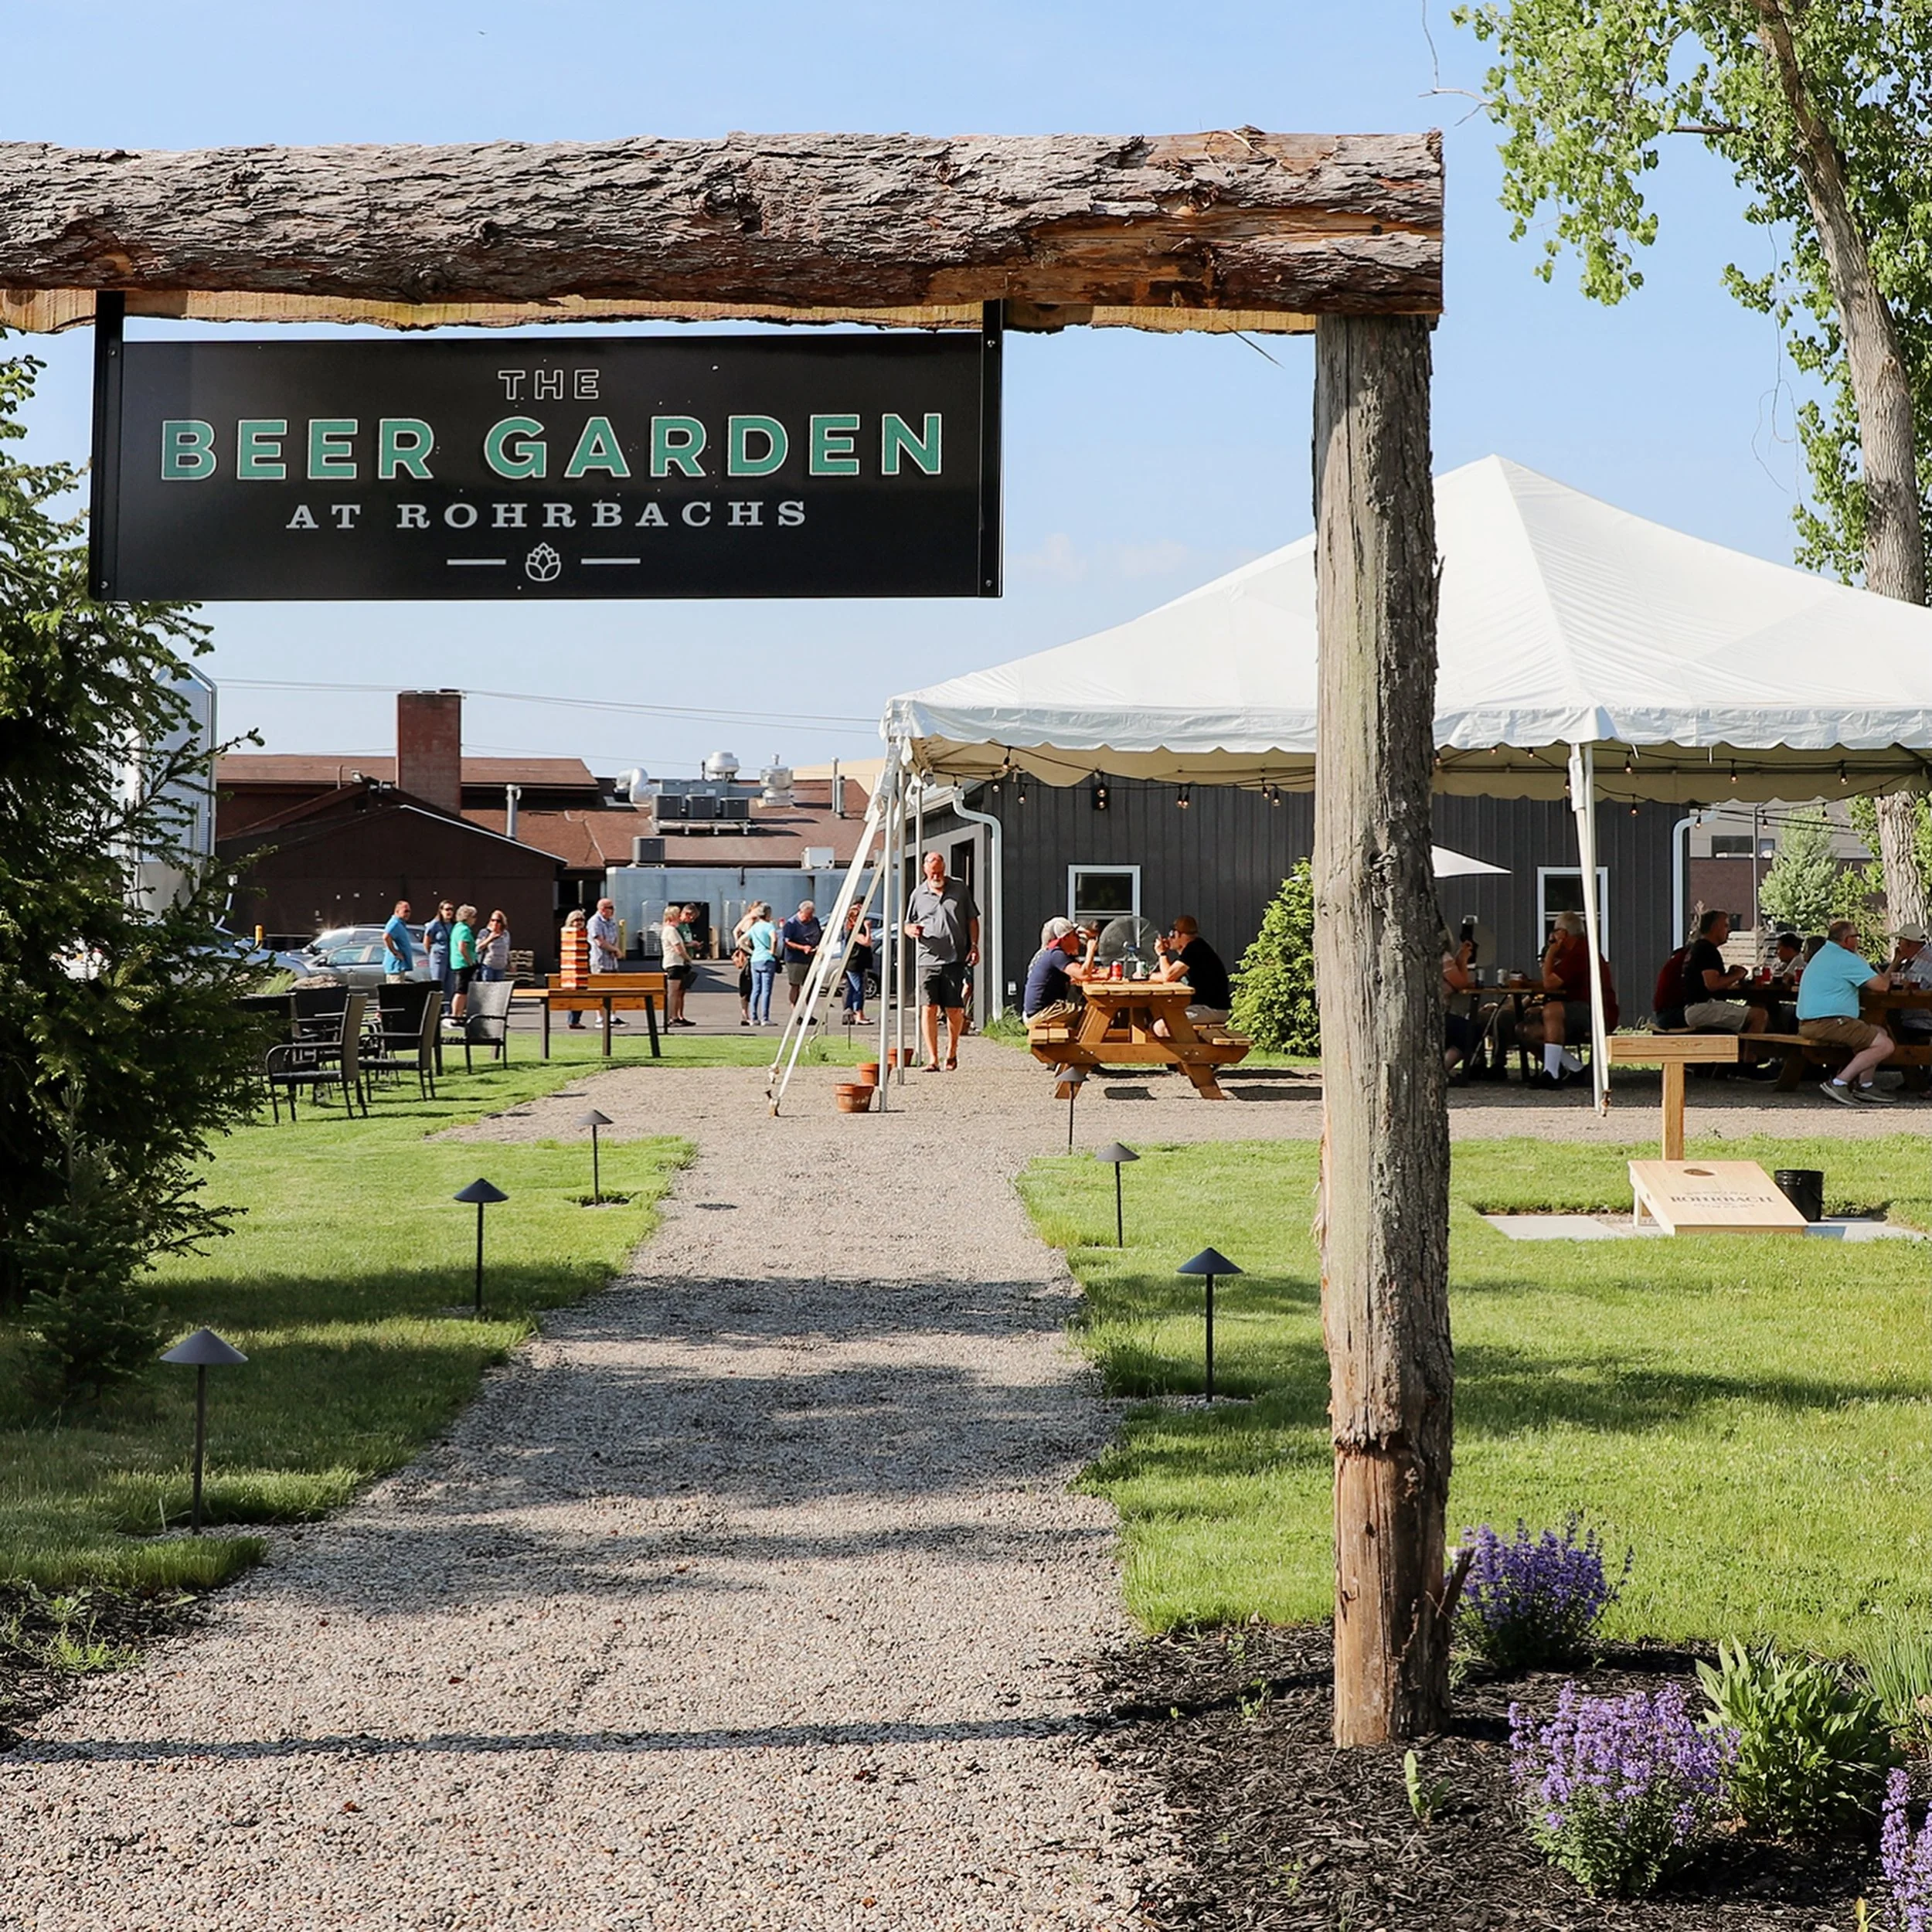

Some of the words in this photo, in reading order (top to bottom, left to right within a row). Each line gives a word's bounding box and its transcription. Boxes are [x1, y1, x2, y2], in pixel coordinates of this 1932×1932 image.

[498, 369, 600, 400] THE
[160, 417, 435, 481] BEER
[483, 412, 943, 481] GARDEN
[285, 504, 361, 529] AT
[396, 499, 806, 529] ROHRBACHS
